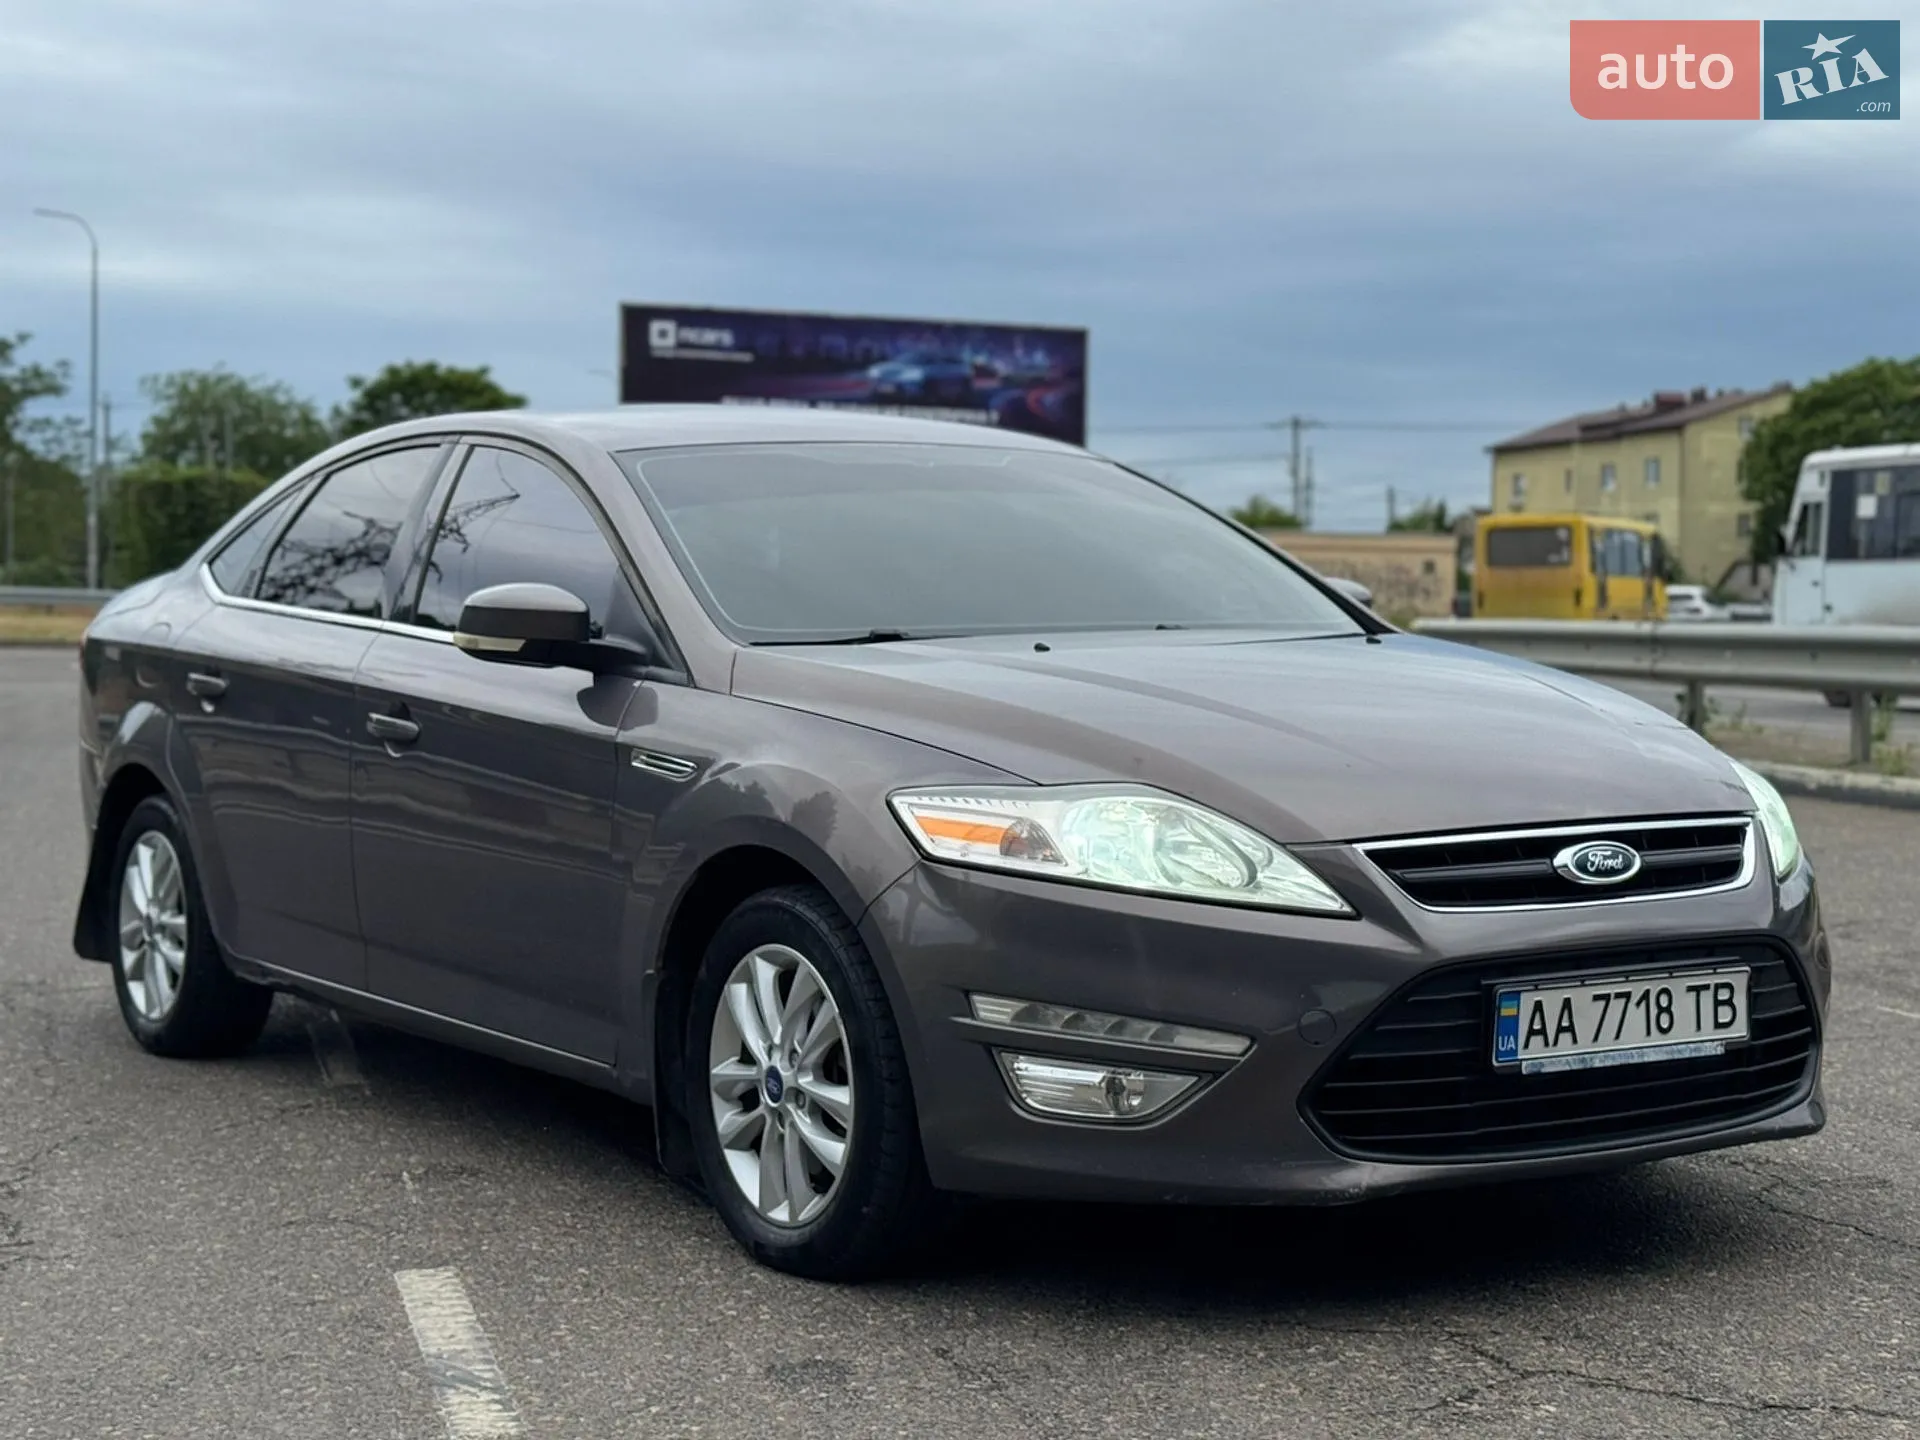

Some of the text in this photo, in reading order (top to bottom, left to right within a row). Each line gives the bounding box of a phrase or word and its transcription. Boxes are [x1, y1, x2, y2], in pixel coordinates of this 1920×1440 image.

[1587, 851, 1624, 872] Ford
[1523, 982, 1737, 1049] AA 7718 TB
[1499, 1036, 1515, 1050] UA
